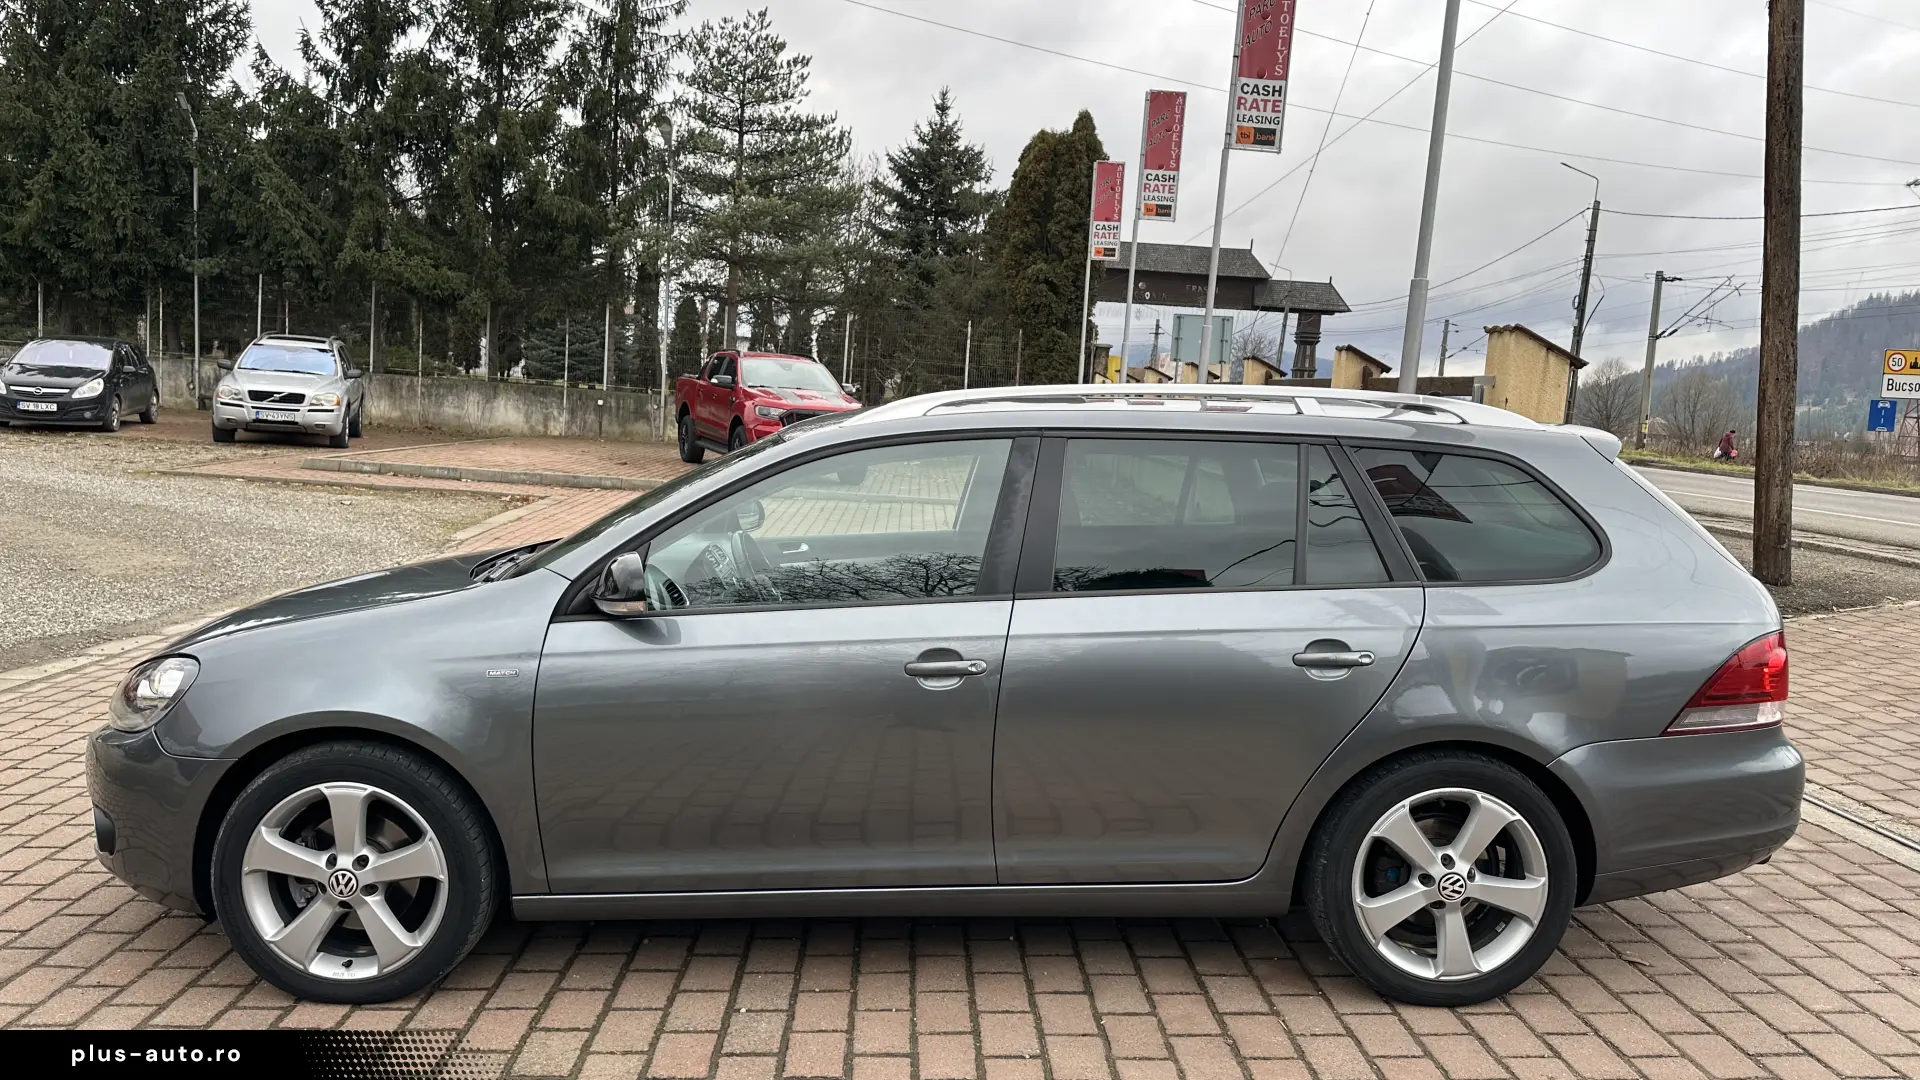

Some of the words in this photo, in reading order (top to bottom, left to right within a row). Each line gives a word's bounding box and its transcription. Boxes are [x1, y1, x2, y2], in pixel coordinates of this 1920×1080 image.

[1245, 20, 1273, 48] AUTO
[1240, 82, 1283, 98] CASH
[1236, 96, 1283, 113] RATE
[1236, 113, 1281, 126] LEASING
[1169, 96, 1184, 168] AUTOELYS
[1240, 131, 1251, 139] tbi
[1145, 172, 1176, 183] CASH
[1113, 164, 1123, 220] AUTOELYS
[1143, 182, 1176, 194] RATE
[1143, 194, 1175, 203] LEASING
[1095, 223, 1119, 231] CASH
[1093, 231, 1119, 240] RATE
[1891, 357, 1903, 367] 50
